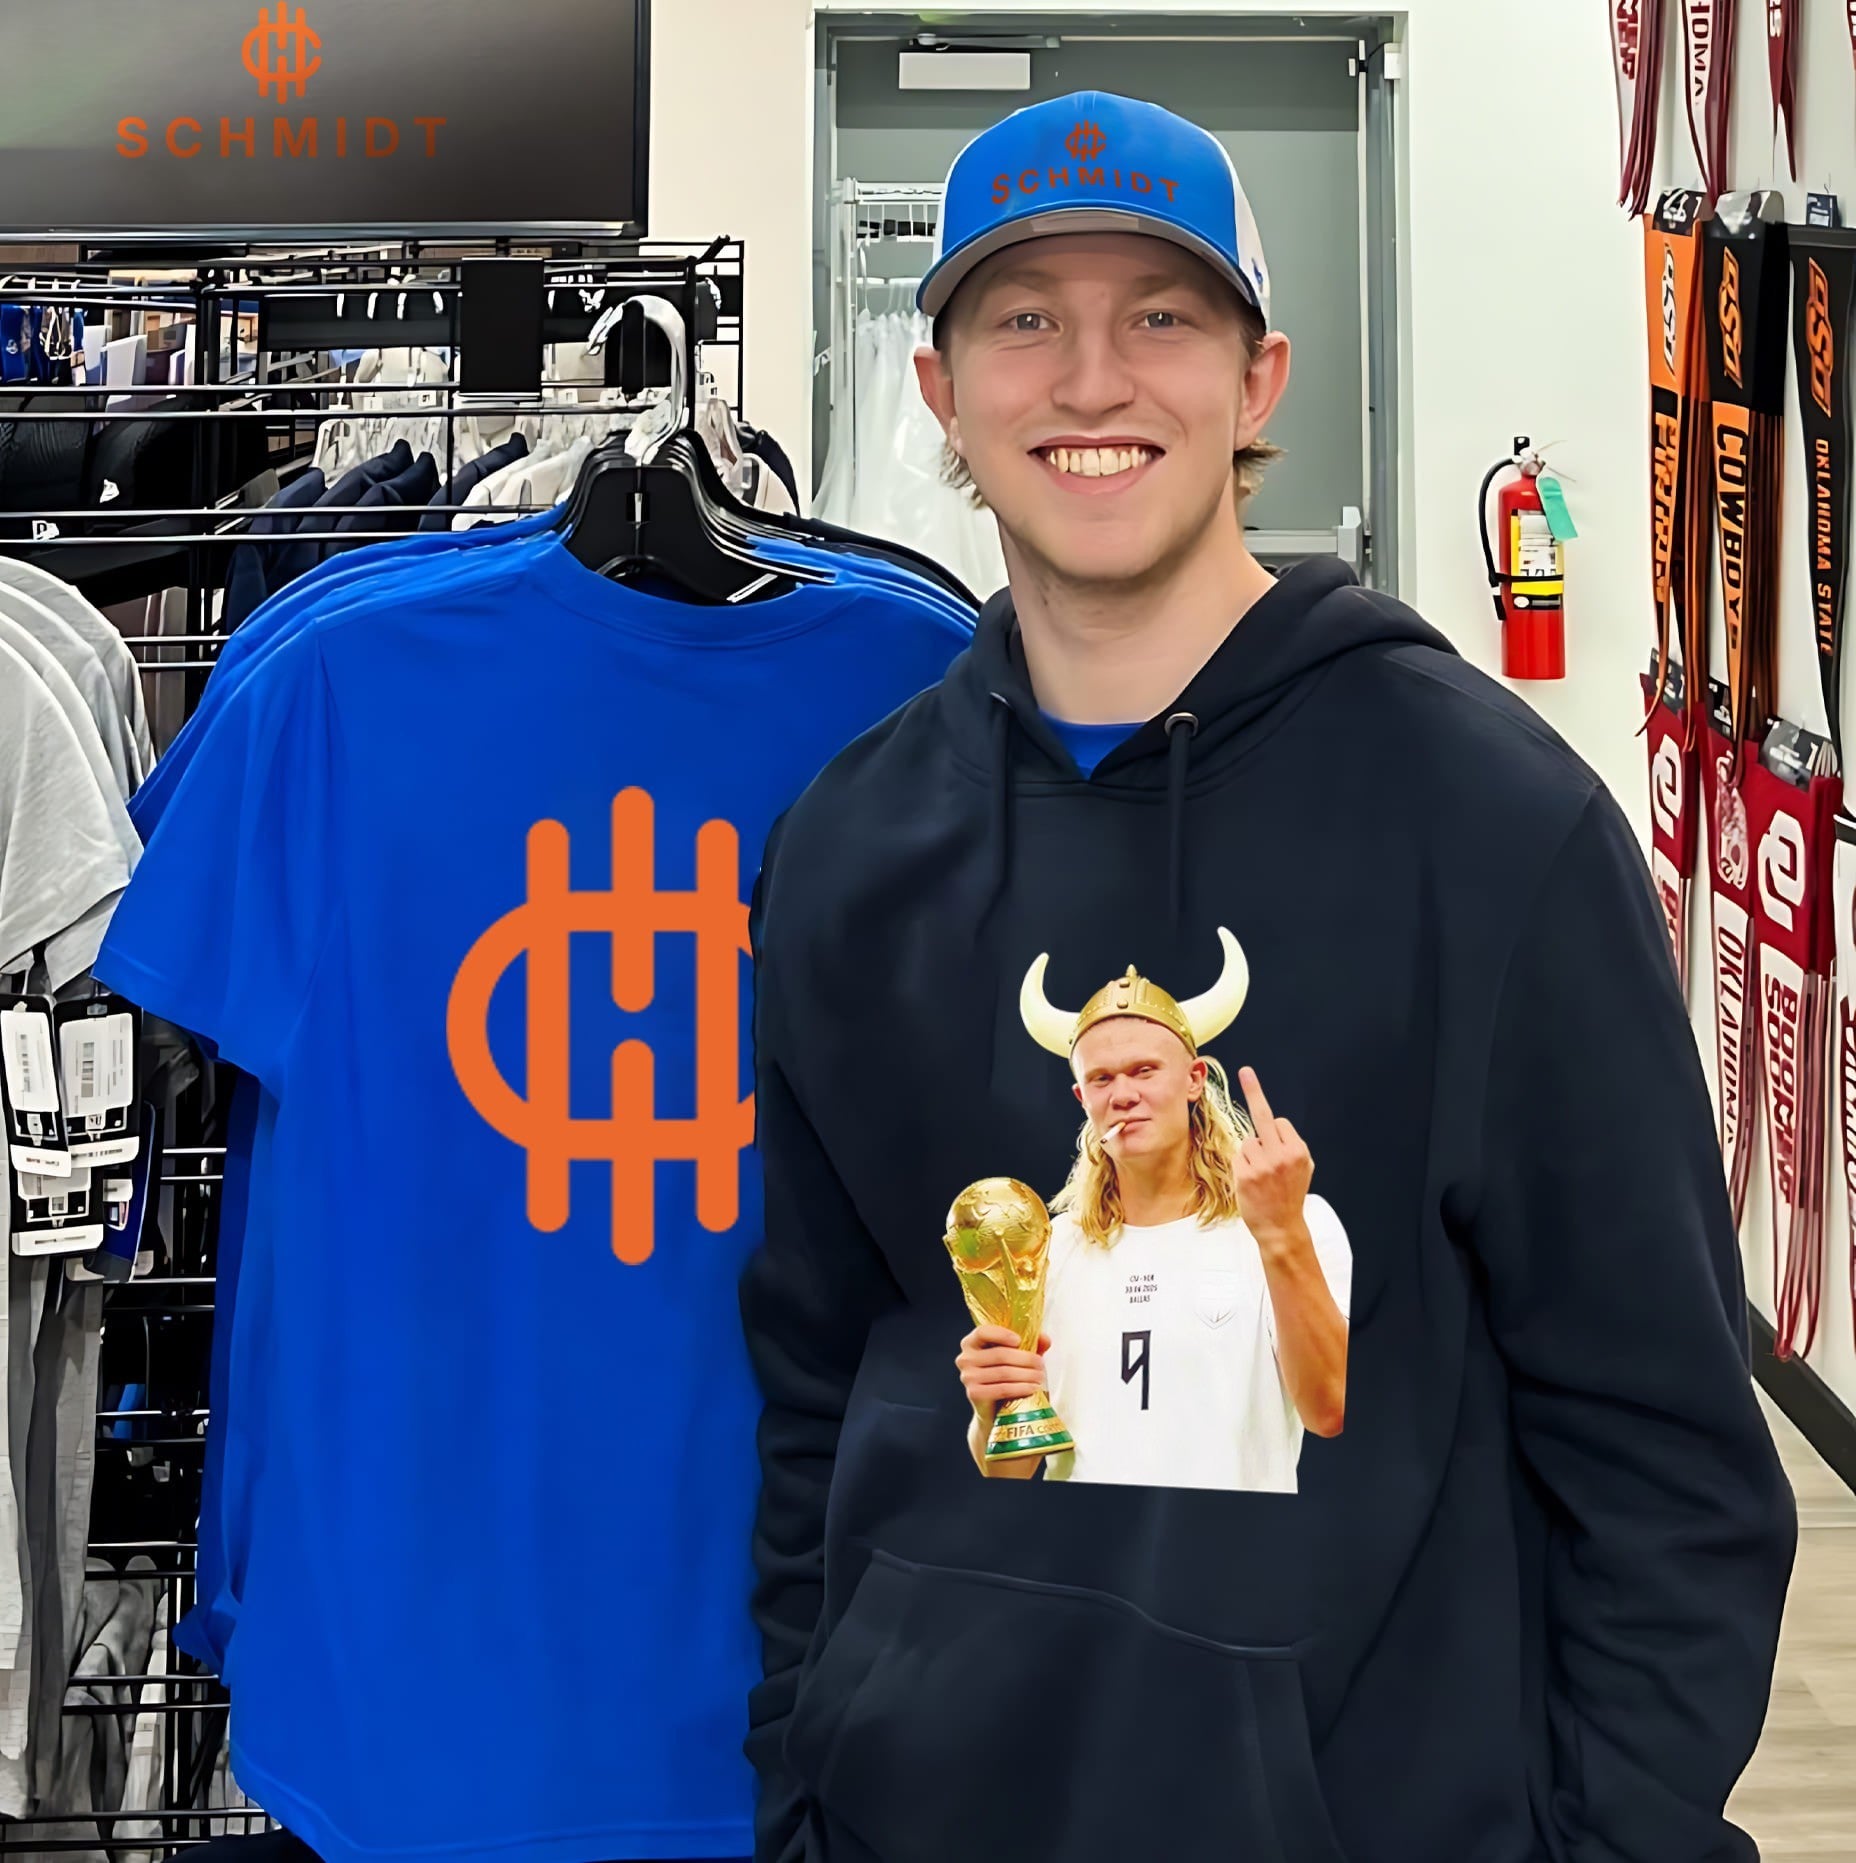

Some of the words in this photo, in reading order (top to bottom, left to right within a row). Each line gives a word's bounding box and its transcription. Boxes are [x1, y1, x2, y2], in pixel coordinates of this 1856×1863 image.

[115, 116, 447, 158] SCHMIDT
[991, 167, 1179, 205] SCHMIDT
[1815, 438, 1832, 571] OKLAHOMA
[1717, 926, 1745, 1144] OKLAHOMA
[1121, 1330, 1151, 1411] 9
[1006, 1424, 1034, 1439] FIFA
